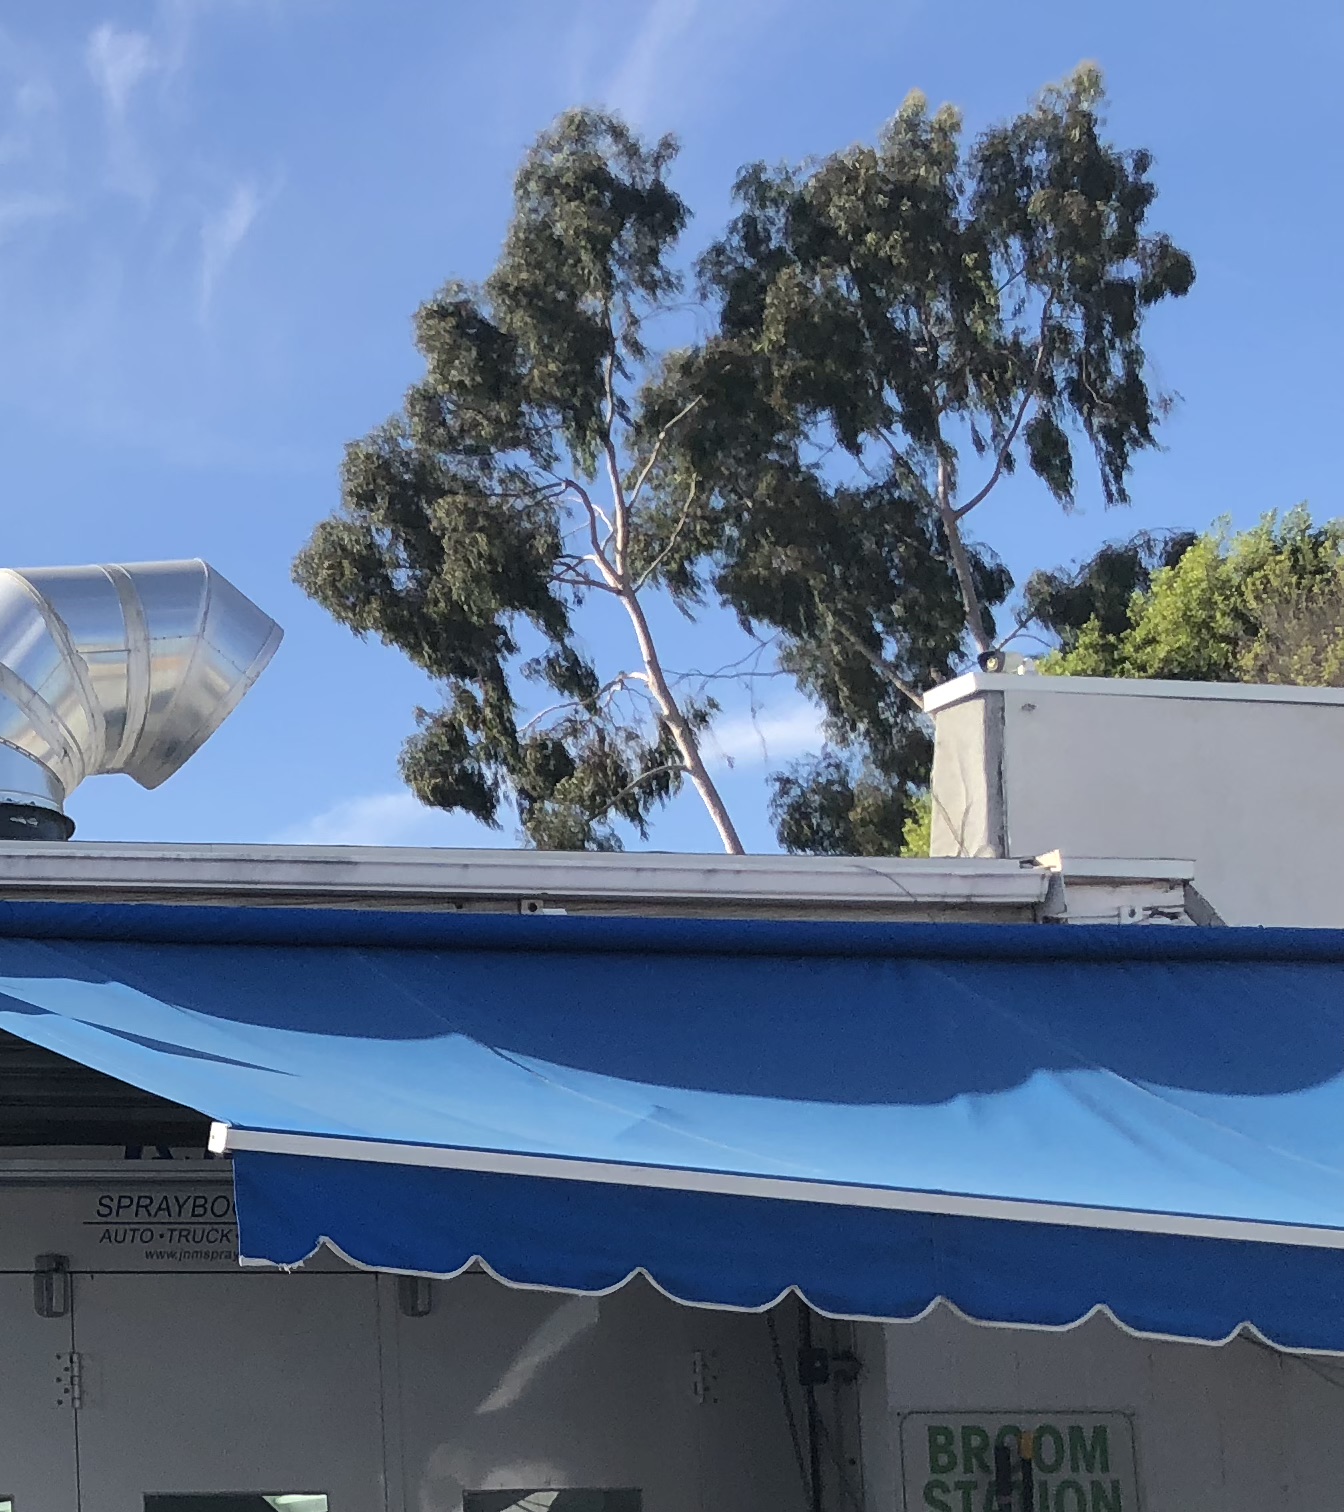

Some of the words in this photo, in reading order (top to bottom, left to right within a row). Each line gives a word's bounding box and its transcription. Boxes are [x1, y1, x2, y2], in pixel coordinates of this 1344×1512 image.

[96, 1195, 237, 1218] SPRAYBO
[99, 1228, 154, 1243] AUTO
[167, 1228, 233, 1243] TRUCK
